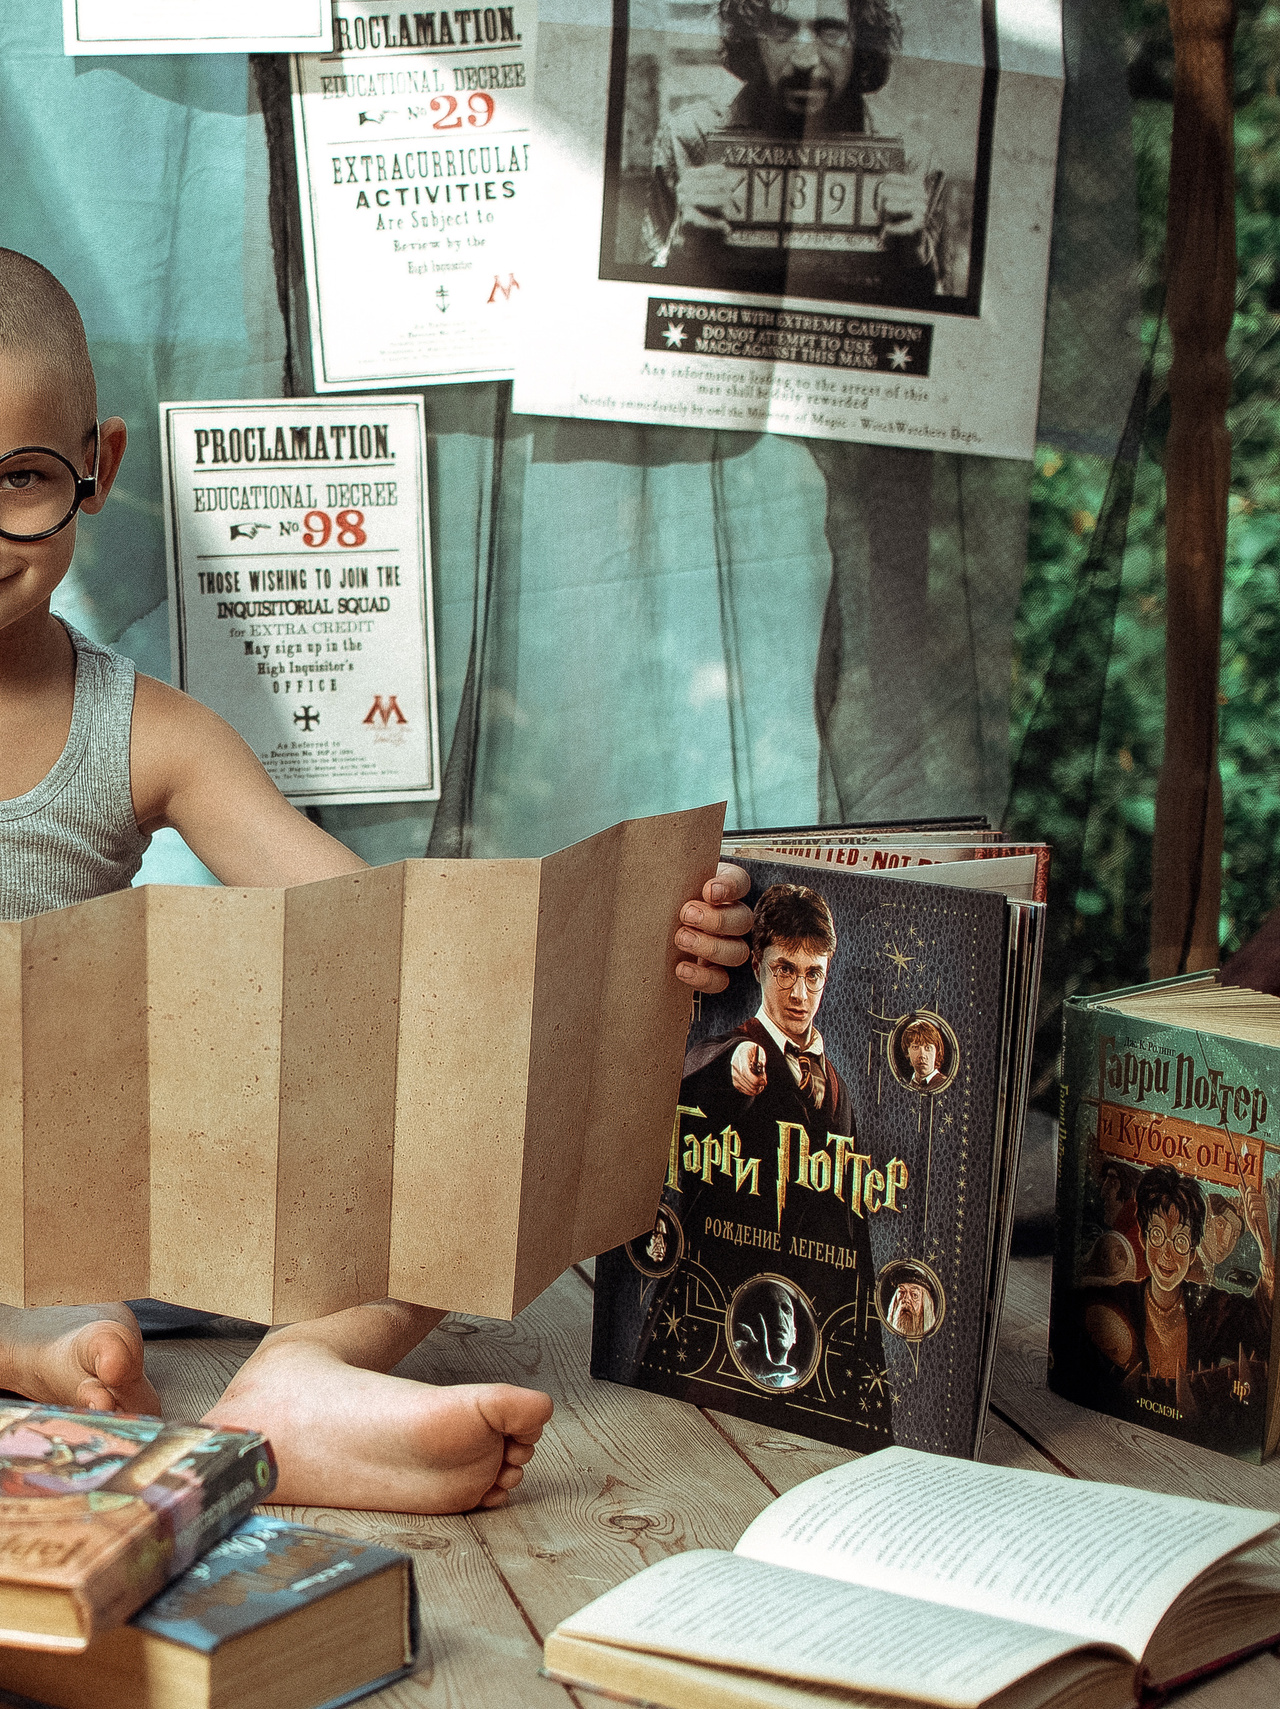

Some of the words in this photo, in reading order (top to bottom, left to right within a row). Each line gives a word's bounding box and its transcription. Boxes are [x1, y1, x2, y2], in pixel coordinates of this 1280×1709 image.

[335, 6, 522, 50] ROCLAMATION.
[320, 69, 444, 100] EDUCATIONAL
[453, 63, 526, 91] DECREE
[430, 92, 496, 130] 29
[722, 145, 810, 165] AZKABAN
[815, 148, 890, 169] PRISON
[356, 181, 516, 209] ACTIVITIES
[376, 214, 404, 231] Are
[411, 210, 469, 232] Subject
[478, 210, 494, 223] to
[447, 237, 461, 251] by
[468, 236, 486, 247] the
[656, 303, 738, 323] APPROACH
[741, 310, 775, 326] WITH
[777, 313, 844, 335] EXTREME
[695, 338, 741, 356] MAGIC
[743, 343, 797, 361] AGAINST
[801, 347, 835, 363] THIS
[702, 324, 725, 339] DO
[728, 327, 755, 342] NOT
[757, 330, 819, 349] ATTEMPT
[821, 335, 840, 351] TO
[843, 338, 874, 354] USE
[641, 362, 666, 377] Any
[671, 366, 745, 383] information
[796, 378, 809, 390] to
[815, 379, 837, 393] the
[841, 383, 880, 398] arrest
[885, 384, 901, 399] of
[807, 394, 869, 411] rewarded
[194, 424, 396, 464] PROCLAMATION.
[193, 484, 317, 513] EDUCATIONAL
[326, 482, 398, 508] DECREE
[302, 509, 367, 548] 98
[198, 571, 241, 594] THOSE
[249, 569, 307, 592] WISHING
[316, 568, 332, 589] TO
[340, 567, 369, 588] JOIN
[377, 566, 401, 587] THE
[217, 599, 333, 619] INQUISITORIAL
[338, 597, 391, 615] SQUAD
[229, 627, 247, 638] for
[250, 623, 307, 637] EXTRA
[312, 620, 375, 634] CREDIT
[244, 641, 270, 658] May
[275, 642, 302, 657] sign
[307, 642, 323, 656] up
[326, 640, 339, 652] in
[343, 638, 363, 651] the
[257, 662, 286, 677] High
[289, 659, 354, 676] Inquisitor's
[273, 678, 338, 694] OFFICE
[291, 741, 329, 749] Referred
[871, 850, 911, 869] NOT
[1099, 1035, 1171, 1104] Гарри
[1171, 1052, 1268, 1134] Поттер
[1102, 1118, 1113, 1136] и
[1118, 1112, 1193, 1160] Кубок
[1196, 1142, 1258, 1177] огня
[665, 1105, 762, 1195] Гарри
[776, 1119, 909, 1233] Поттер
[704, 1216, 782, 1253] РОЖДЕНИЕ
[789, 1235, 858, 1271] ЛЕГЕНДЫ
